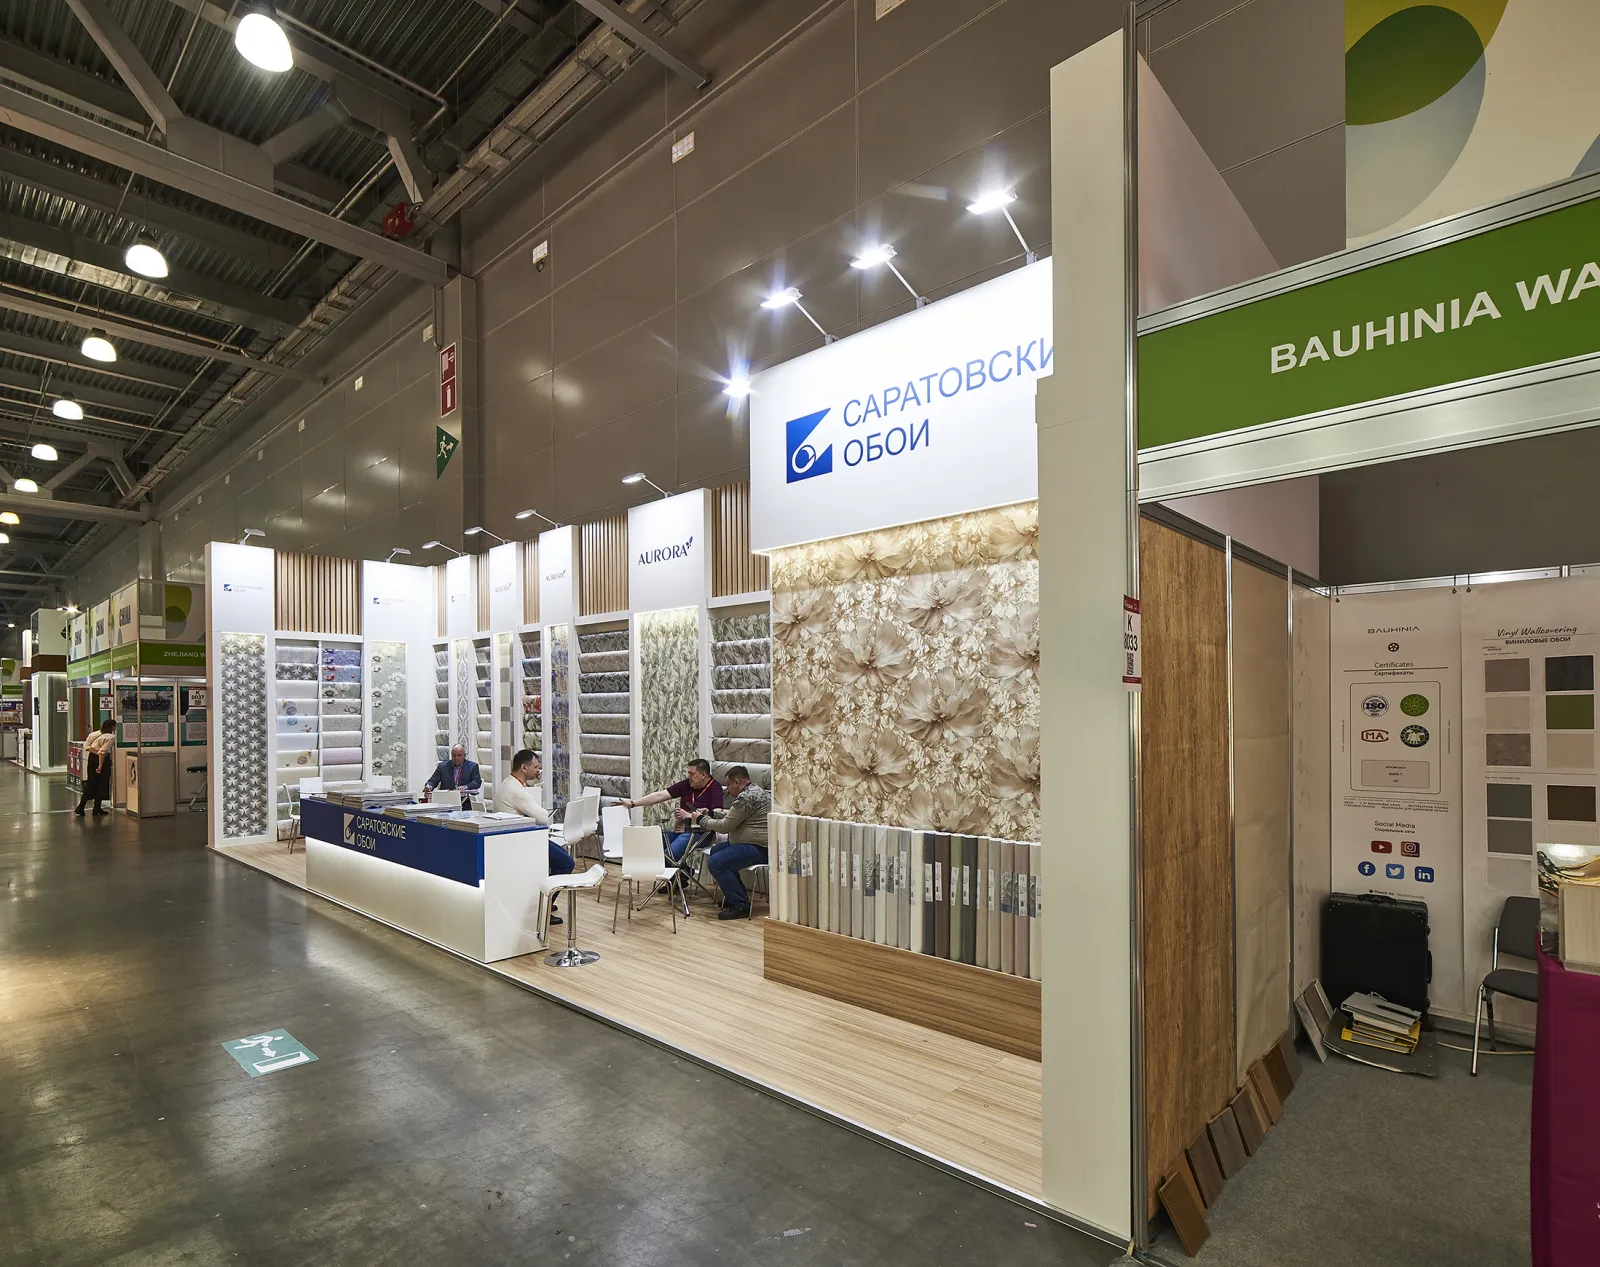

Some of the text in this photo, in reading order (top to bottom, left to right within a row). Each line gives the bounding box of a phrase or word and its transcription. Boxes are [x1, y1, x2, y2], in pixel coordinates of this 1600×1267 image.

[1271, 291, 1502, 374] BAUHINIA
[843, 419, 930, 467] ОБОИ
[638, 543, 688, 566] AURORA
[1128, 614, 1132, 632] K
[1368, 626, 1420, 634] BAUHINIA
[1497, 626, 1577, 639] Vinyl Wallcovering
[1124, 633, 1138, 651] 8033
[1365, 702, 1386, 710] ISO
[356, 816, 406, 840] САРАТОВСКИЕ
[356, 834, 376, 850] ОБОИ
